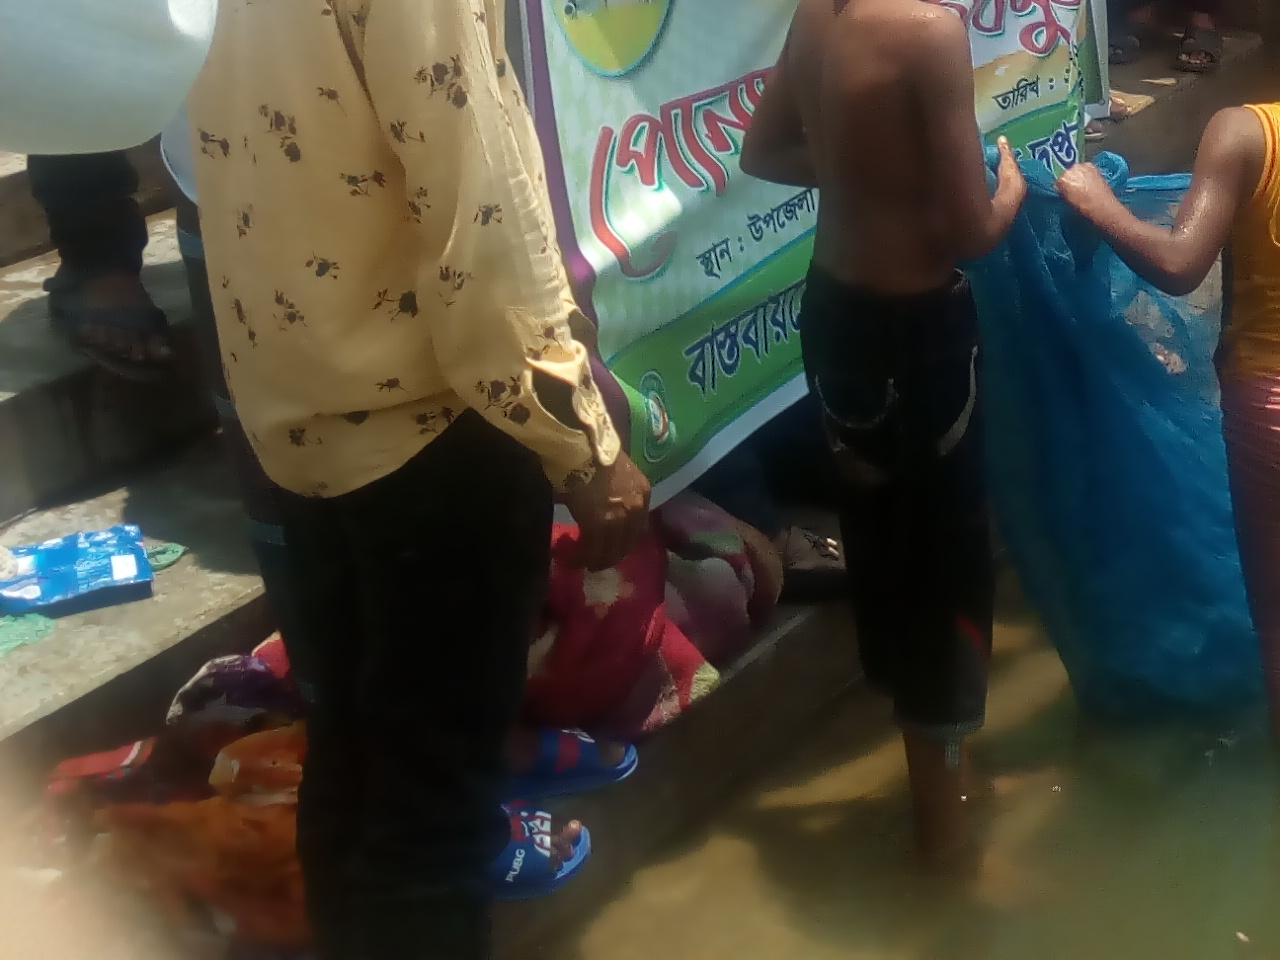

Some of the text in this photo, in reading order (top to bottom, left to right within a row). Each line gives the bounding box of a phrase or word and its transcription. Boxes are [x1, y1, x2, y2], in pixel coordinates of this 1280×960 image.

[992, 75, 1040, 110] তারিখ
[696, 237, 732, 279] স্থান
[746, 187, 816, 241] উপজেলা
[505, 848, 526, 882] PUBG
